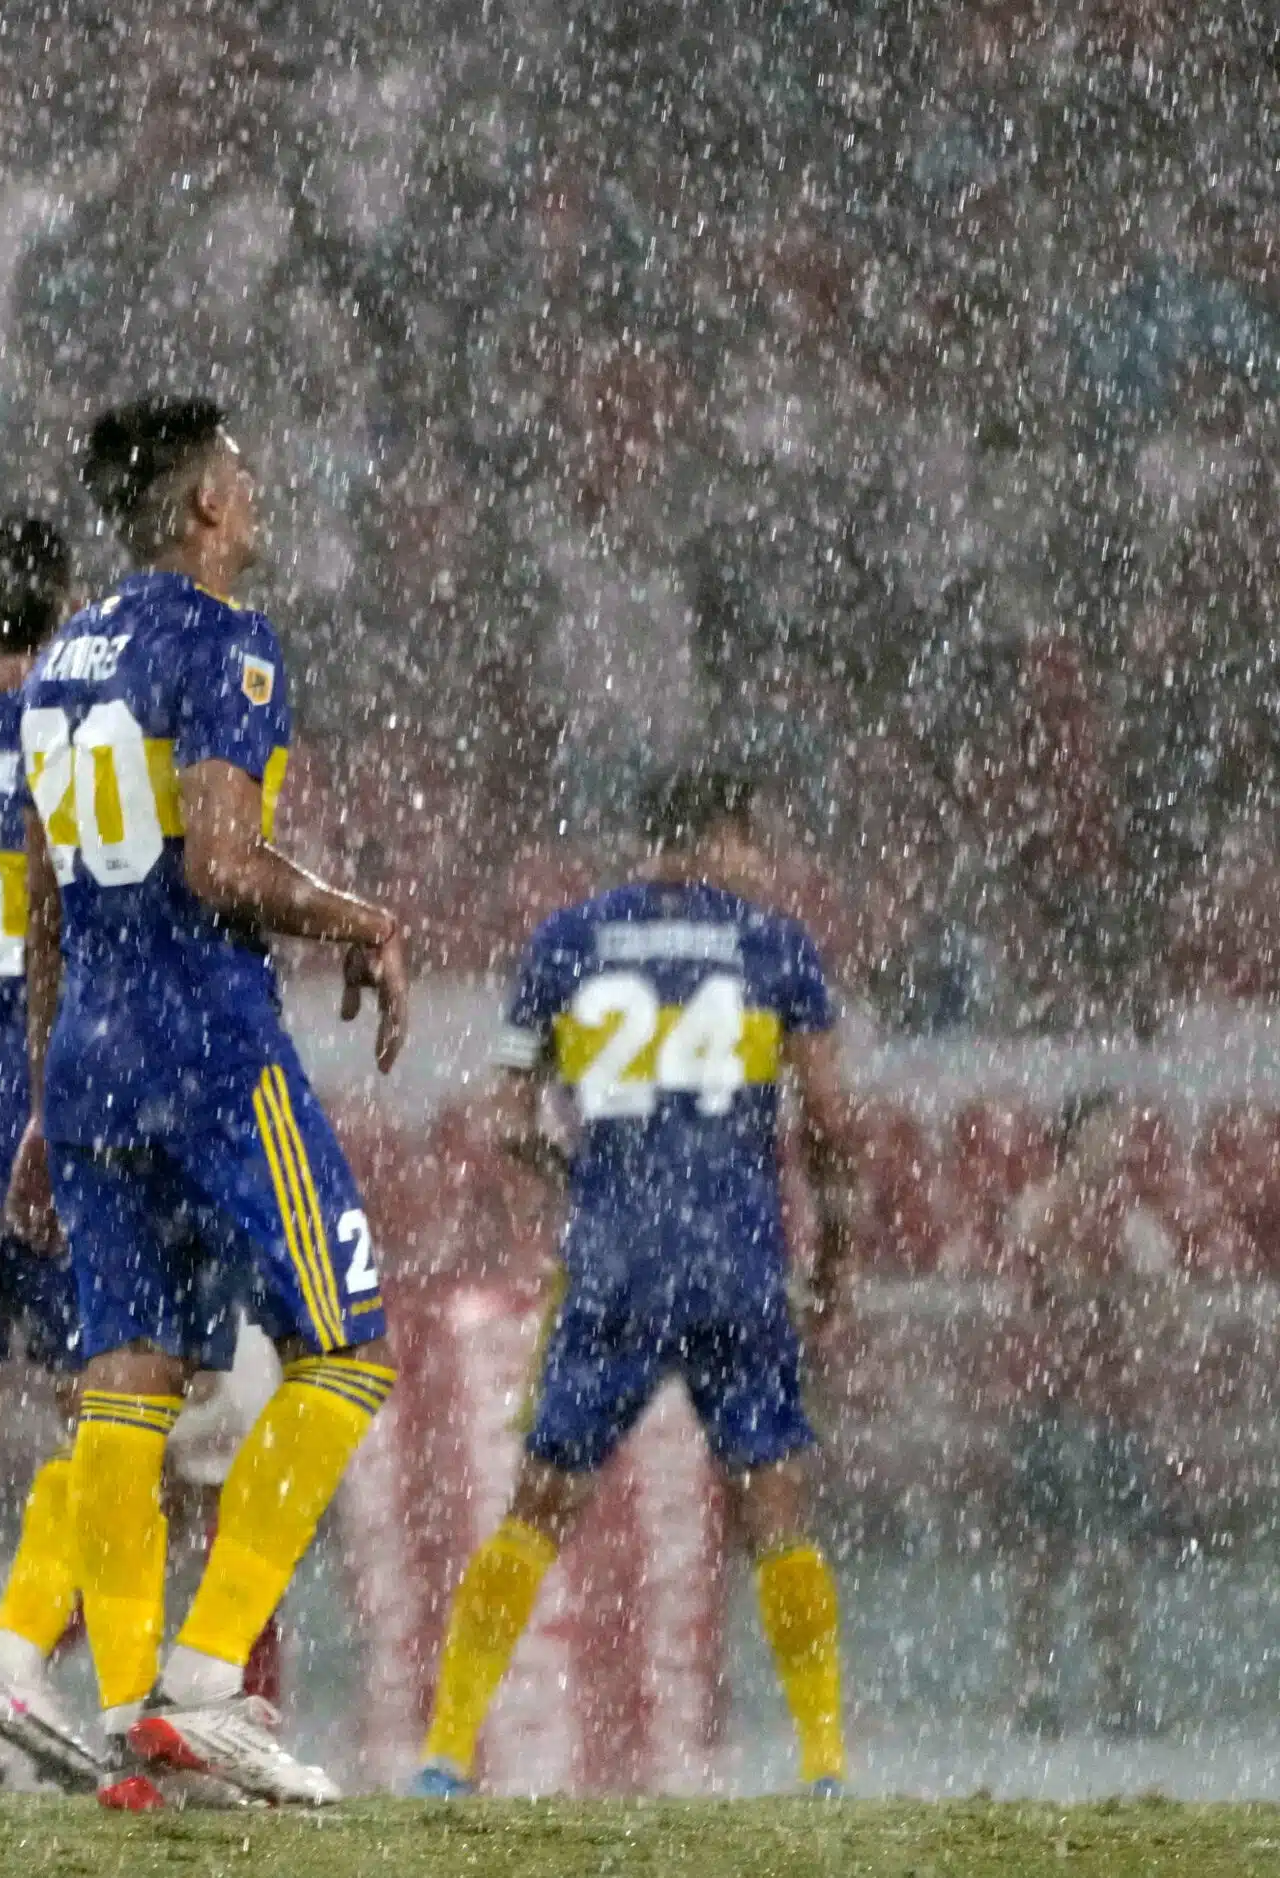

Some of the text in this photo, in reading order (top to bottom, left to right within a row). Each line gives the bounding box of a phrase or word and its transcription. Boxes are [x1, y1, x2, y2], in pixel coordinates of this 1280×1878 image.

[20, 699, 165, 888] 20
[574, 971, 746, 1119] 24
[337, 1208, 380, 1294] 2
